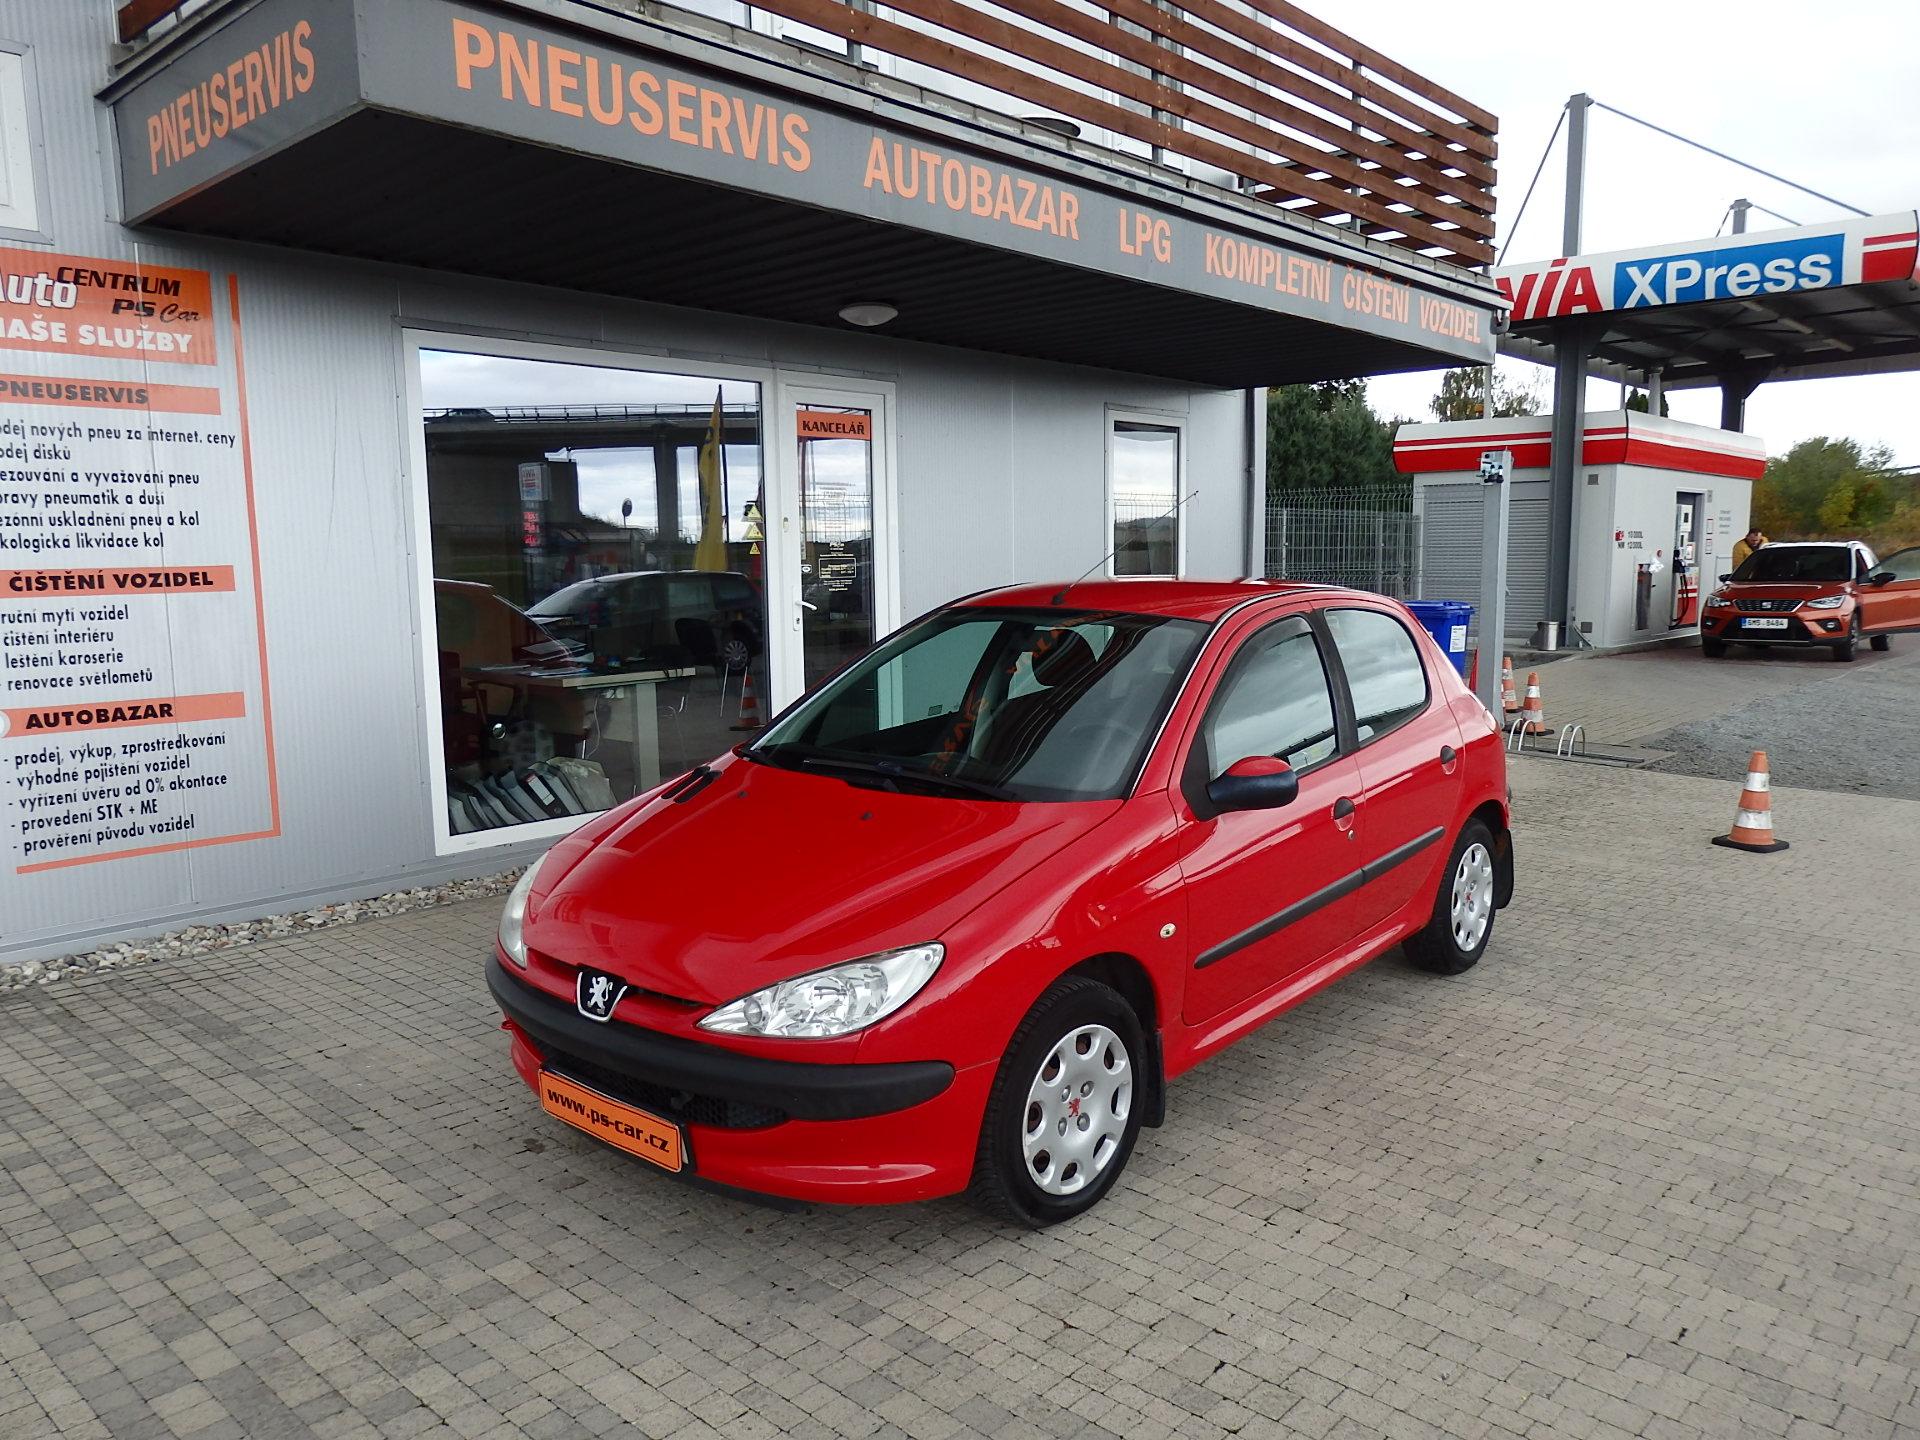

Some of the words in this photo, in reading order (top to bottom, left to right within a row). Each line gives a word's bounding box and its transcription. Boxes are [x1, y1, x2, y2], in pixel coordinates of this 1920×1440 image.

[147, 20, 315, 176] PNEUSERVIS
[452, 18, 811, 172] PNEUSERVIS
[863, 137, 1079, 241] AUTOBAZAR
[1119, 208, 1172, 264] LPG
[1206, 233, 1333, 303] KOMPLETNÍ
[1342, 264, 1410, 324] ČIŠTĚNÍ
[1419, 296, 1481, 344] VOZIDEL
[57, 267, 181, 297] CENTRUM
[1623, 253, 1833, 309] XPress
[112, 299, 157, 318] PS
[160, 303, 201, 323] Car
[78, 322, 192, 353] SLUŽBY
[0, 419, 25, 439] dej
[31, 421, 82, 441] nových
[88, 428, 121, 442] pneu
[126, 429, 142, 440] za
[147, 425, 202, 443] internet.
[207, 433, 235, 448] ceny
[802, 420, 865, 435] KANCELÁŘ
[71, 472, 79, 482] a
[85, 469, 164, 487] vyvažování
[168, 474, 199, 488] pneu
[44, 489, 120, 508] pneumatik
[125, 494, 133, 504] a
[48, 510, 125, 527] uskladnění
[130, 515, 162, 530] pneu
[167, 515, 175, 526] a
[180, 510, 199, 526] kol
[76, 532, 139, 548] likvidace
[144, 531, 164, 548] kol
[9, 570, 105, 592] ČIŠTĚNÍ
[113, 571, 214, 589] VOZIDEL
[1, 607, 37, 624] ruční
[80, 604, 129, 621] vozidel
[3, 630, 49, 646] čištění
[54, 627, 114, 644] interiéru
[5, 652, 53, 668] leštění
[58, 647, 124, 666] karoserie
[7, 675, 73, 691] renovace
[79, 667, 153, 686] světlometů
[25, 703, 174, 730] AUTOBAZAR
[15, 746, 64, 770] prodej,
[69, 742, 116, 763] výkup,
[121, 731, 226, 758] zprostředkování
[17, 767, 79, 791] výhodné
[84, 760, 140, 783] pojištění
[144, 753, 190, 773] vozidel
[20, 788, 77, 812] vyřízení
[82, 786, 120, 802] úvěru
[125, 779, 141, 796] od
[146, 777, 165, 793] 0%
[169, 774, 227, 791] akontace
[22, 808, 92, 835] provedení
[97, 803, 123, 821] STK
[140, 798, 158, 815] ME
[24, 828, 91, 856] prověření
[96, 821, 144, 845] původu
[149, 814, 195, 834] vozidel
[546, 1088, 670, 1153] www.ps-car.cz
